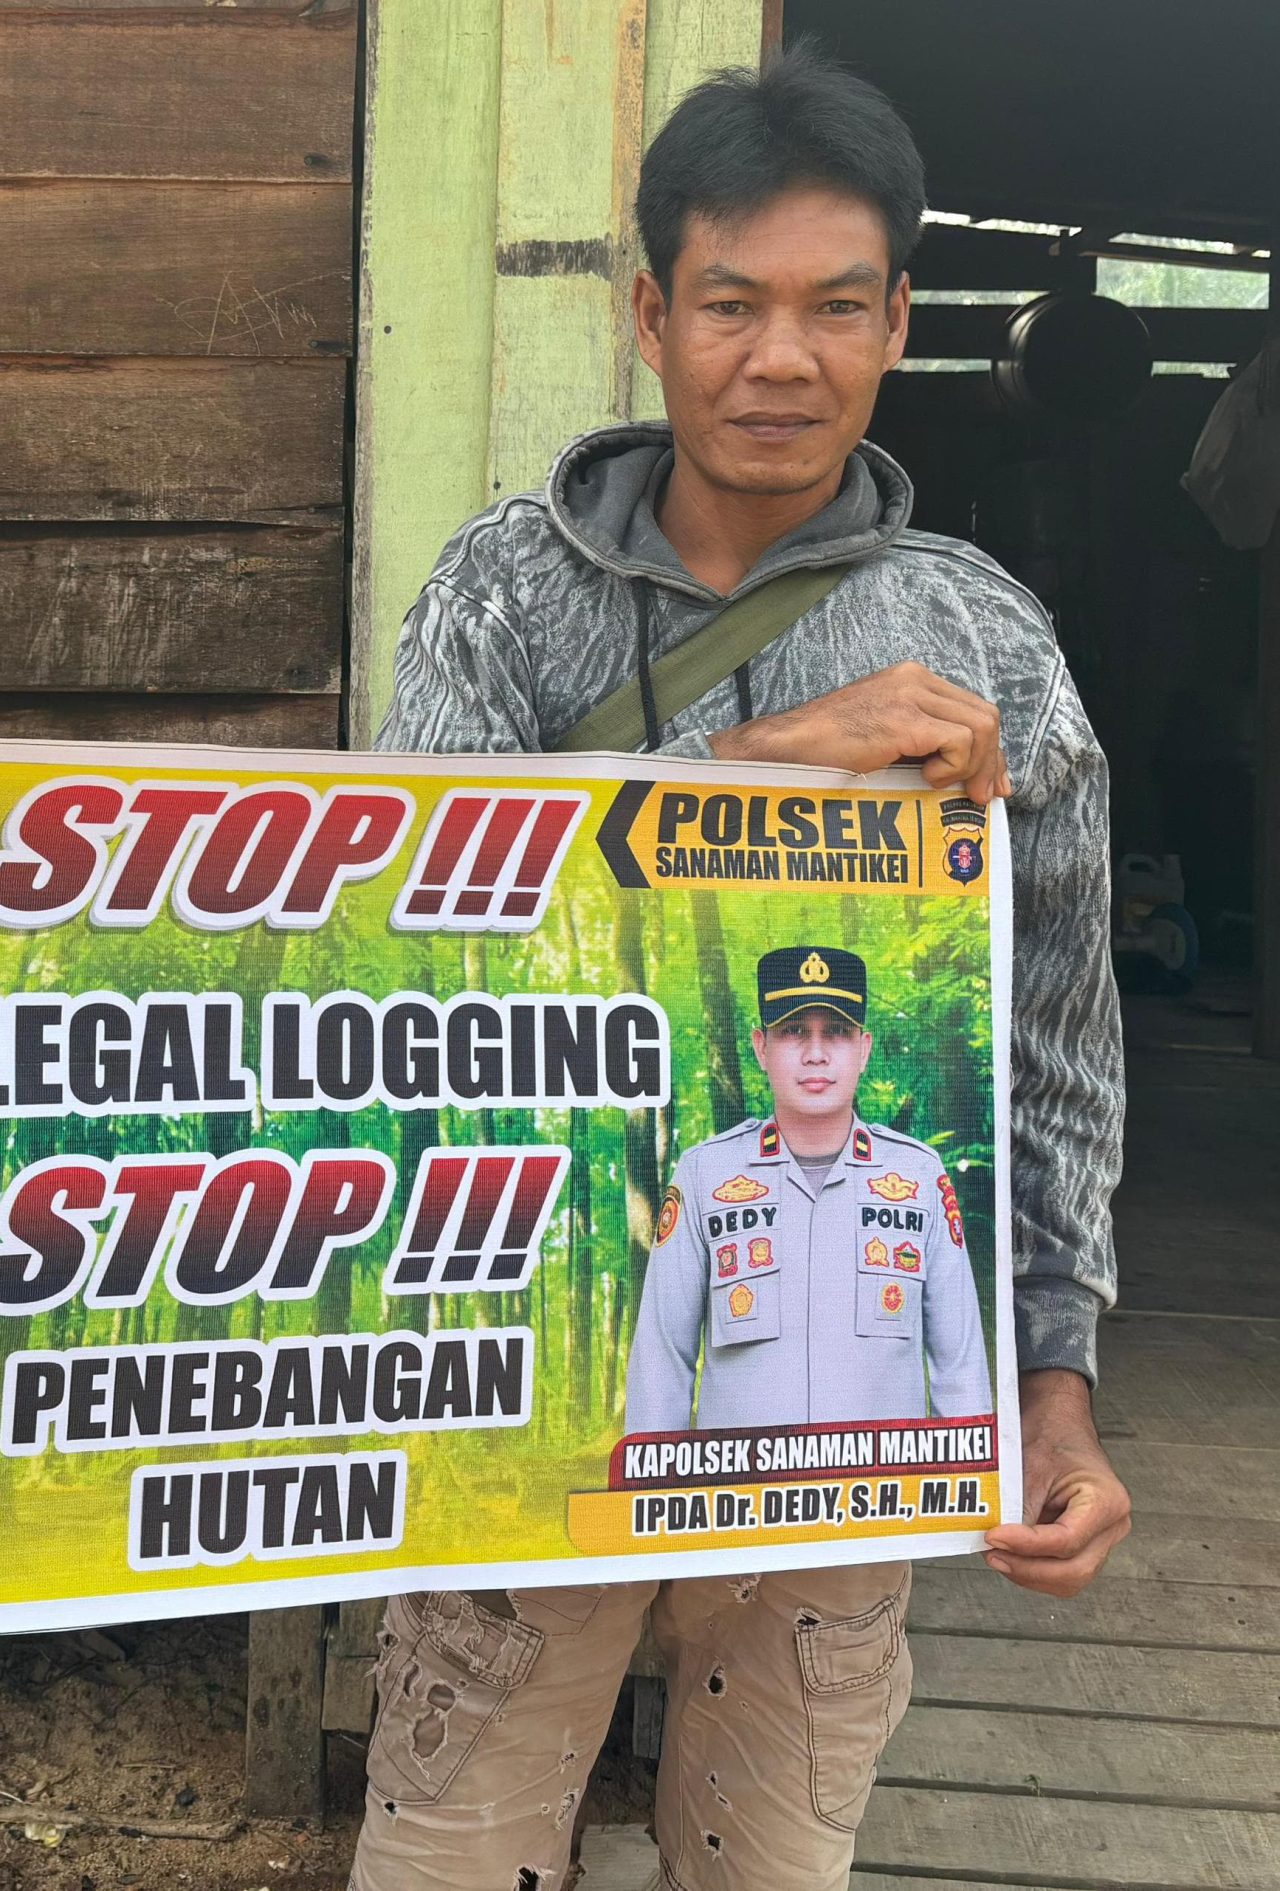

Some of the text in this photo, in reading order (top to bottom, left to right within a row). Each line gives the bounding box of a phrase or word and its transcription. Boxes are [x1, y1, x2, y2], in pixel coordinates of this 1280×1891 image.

[657, 793, 907, 851] POLSEK
[404, 797, 581, 917] !!!
[656, 846, 909, 883] SANAMAN MANTIKEI
[271, 1002, 661, 1099] LOGGING
[393, 1155, 563, 1286] !!!
[708, 1207, 777, 1238] DEDY
[862, 1207, 924, 1233] POLRI
[11, 1337, 524, 1445] PENEBANGAN
[625, 1427, 992, 1479] KAPOLSEK SANAMAN MANTIKEI
[139, 1461, 398, 1559] HUTAN
[635, 1480, 986, 1533] IPDA Dr. DEDY, S.H., M.H.
